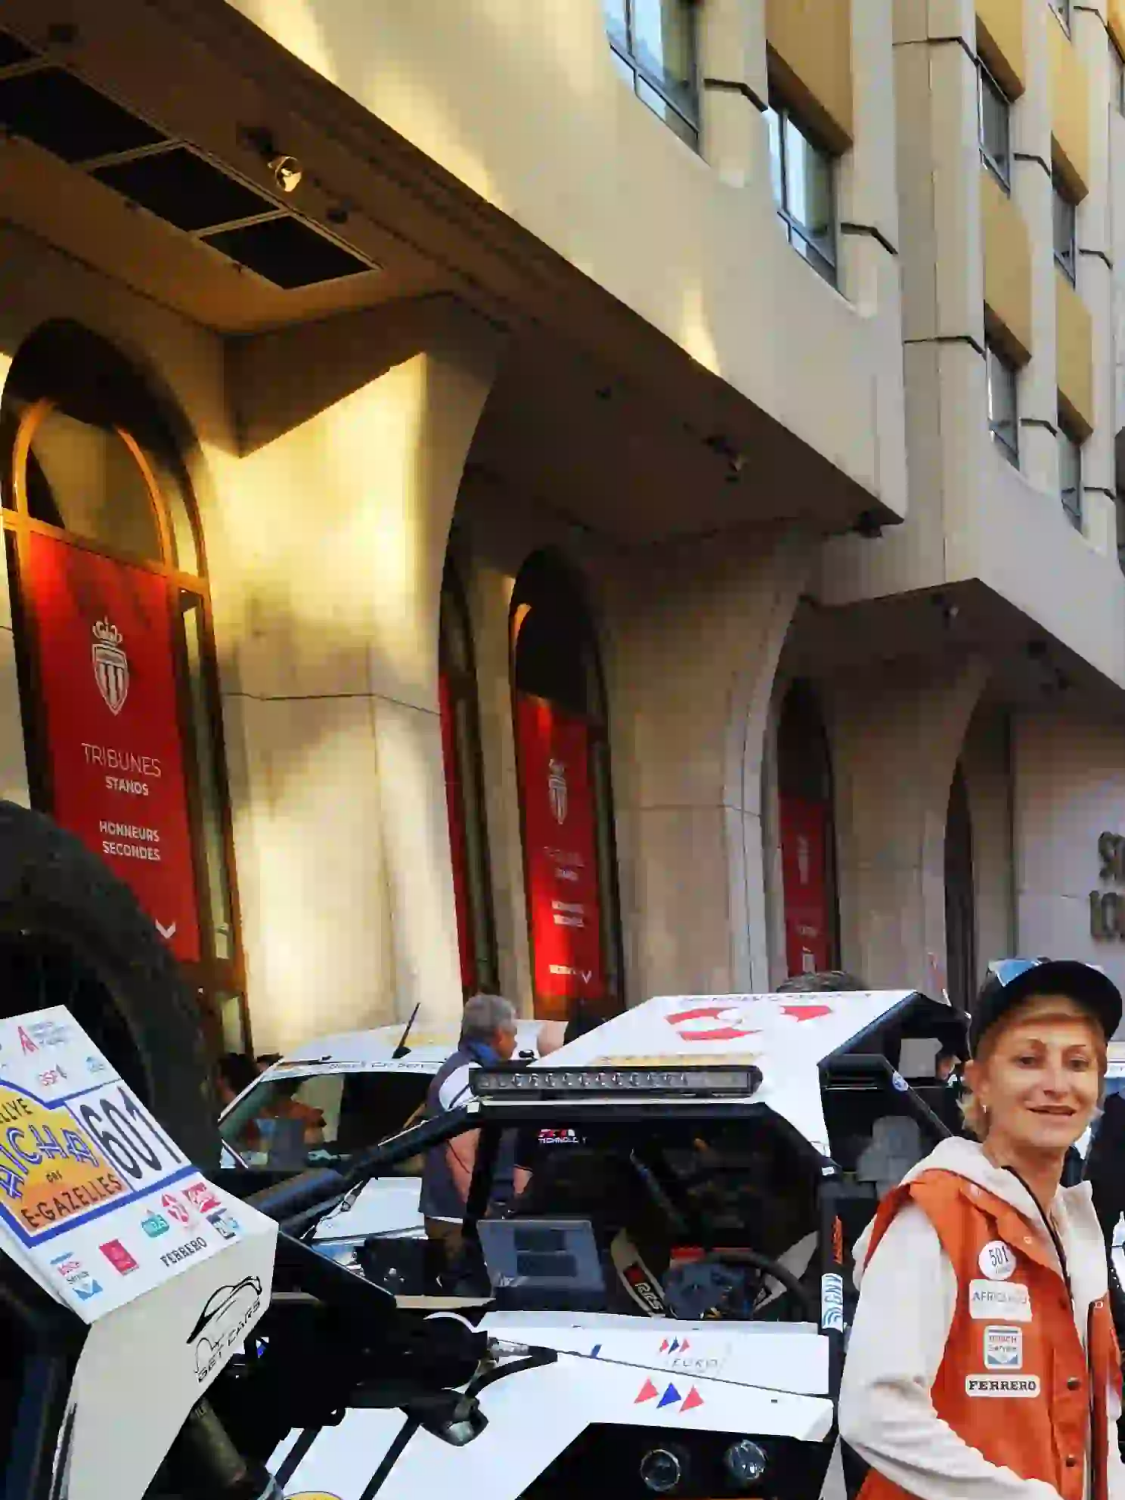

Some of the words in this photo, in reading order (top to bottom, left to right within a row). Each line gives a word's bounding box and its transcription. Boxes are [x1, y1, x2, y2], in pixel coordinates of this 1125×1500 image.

[81, 743, 161, 777] TRIBUNES
[106, 776, 149, 796] STANDS
[99, 821, 160, 842] HONNEURS
[103, 841, 161, 861] SECONDES
[80, 1086, 182, 1180] 601
[160, 1236, 208, 1267] FERRERO
[988, 1245, 1008, 1267] 501
[968, 1380, 1037, 1391] FERRERO
